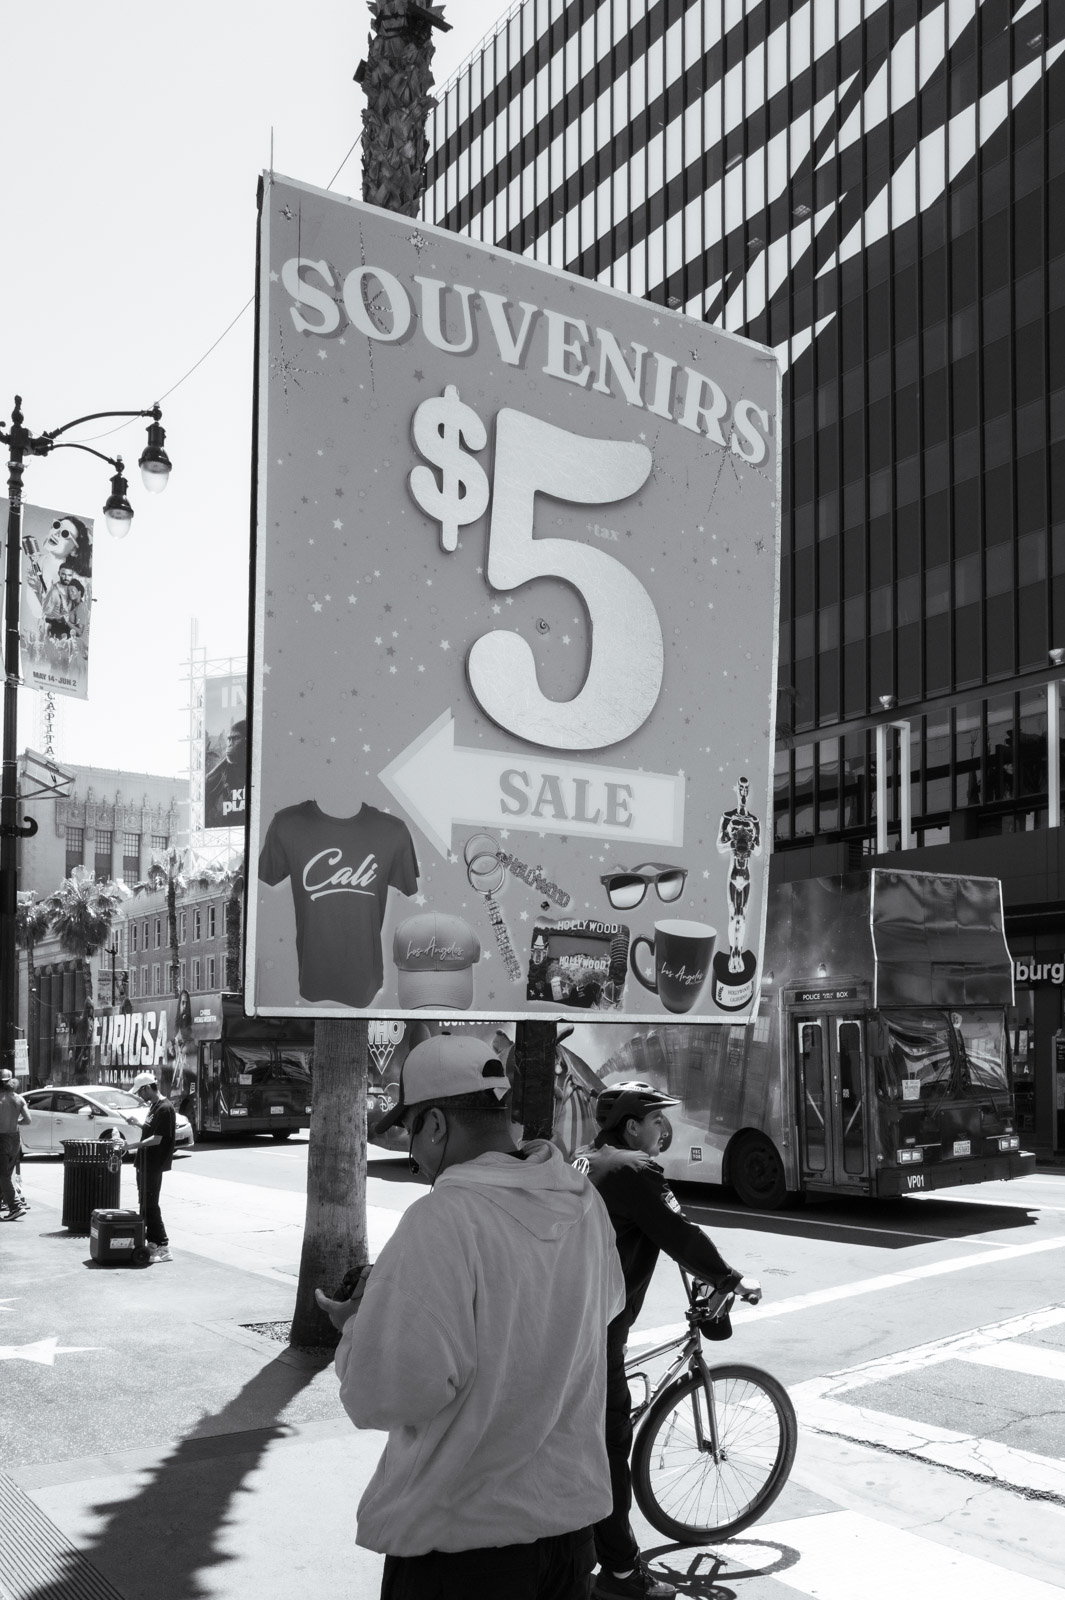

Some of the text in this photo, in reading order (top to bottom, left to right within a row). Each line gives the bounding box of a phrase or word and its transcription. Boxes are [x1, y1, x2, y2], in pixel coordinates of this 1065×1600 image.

[281, 257, 770, 464] SOUVENIRS
[408, 384, 664, 750] $5
[32, 671, 47, 680] MAY
[43, 690, 57, 760] CAPITA
[499, 768, 634, 828] SALE
[302, 847, 379, 893] Cali
[557, 919, 618, 934] HOLLYWOOD
[405, 936, 465, 960] Los Angeles
[560, 955, 607, 970] HOLLYWOOD
[802, 993, 821, 1001] POLICE
[836, 991, 849, 999] BOX
[91, 1010, 168, 1066] FURIOSA
[104, 1069, 118, 1084] MAD
[907, 1175, 925, 1189] VP01
